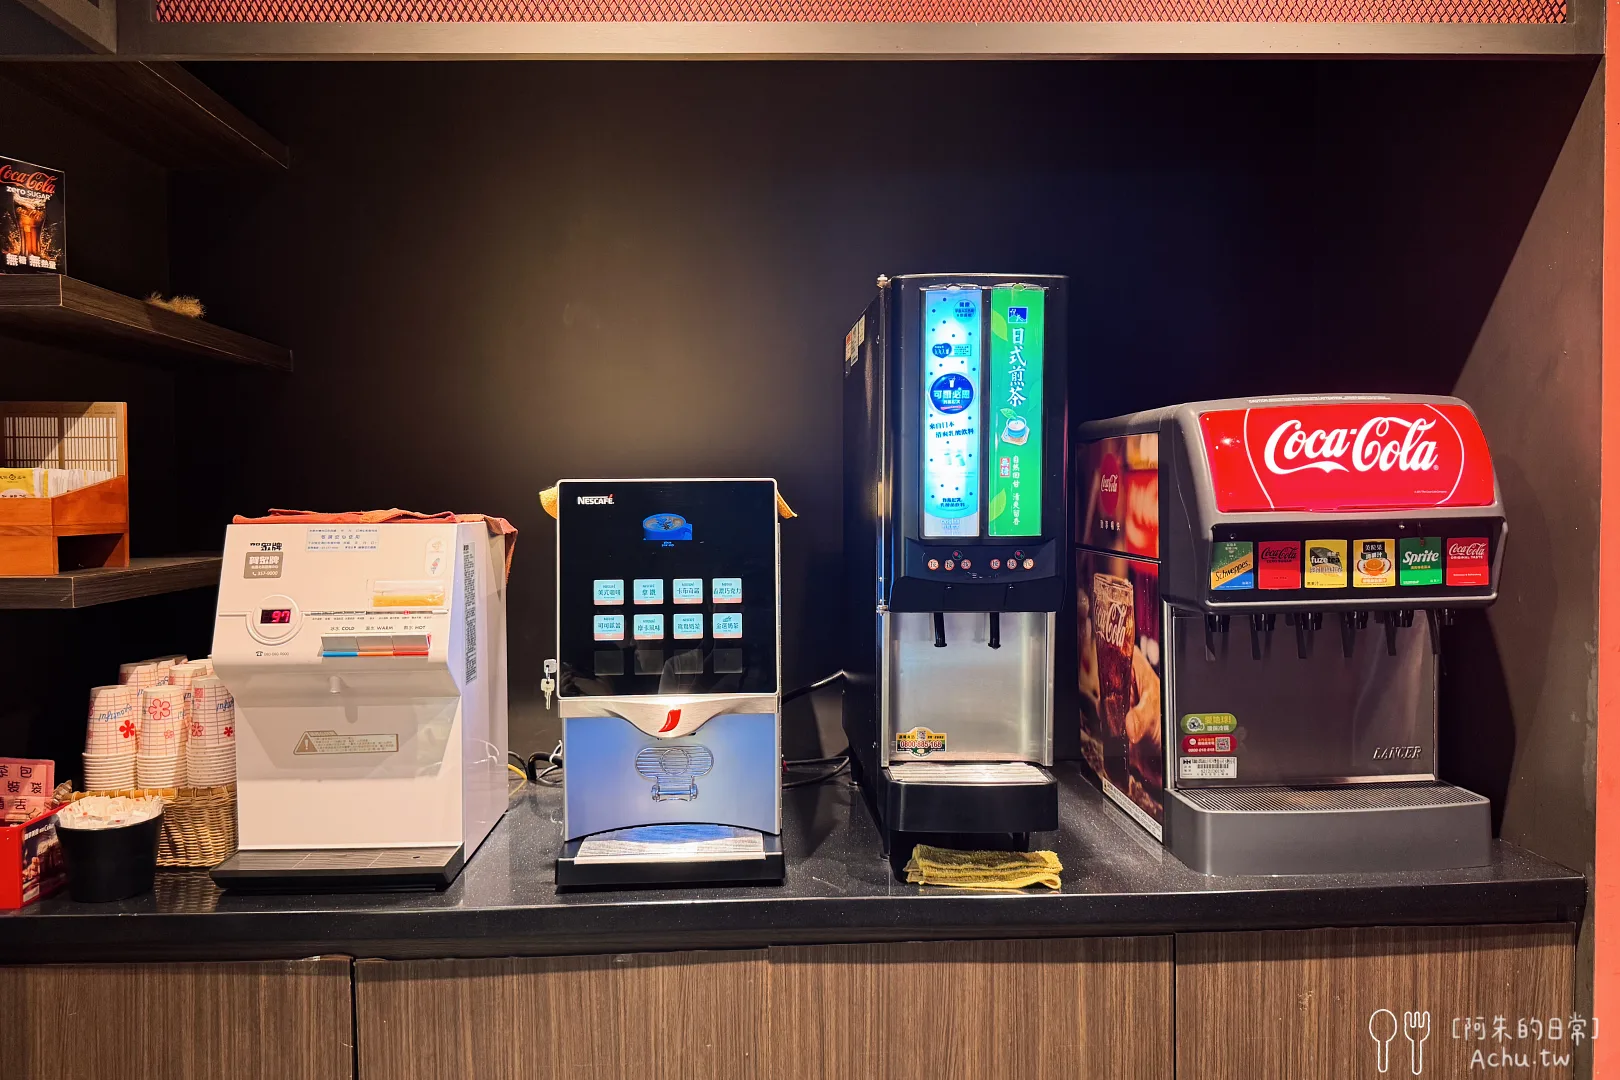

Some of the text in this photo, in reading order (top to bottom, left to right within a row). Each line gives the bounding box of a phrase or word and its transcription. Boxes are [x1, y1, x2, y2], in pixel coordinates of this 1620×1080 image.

[1007, 328, 1026, 407] 日式煎茶
[1264, 416, 1438, 475] Coca-Cola
[1261, 547, 1298, 560] Coca-Cola
[1449, 543, 1486, 556] Coca-Cola
[1403, 550, 1439, 565] Sprite
[272, 610, 290, 622] 97
